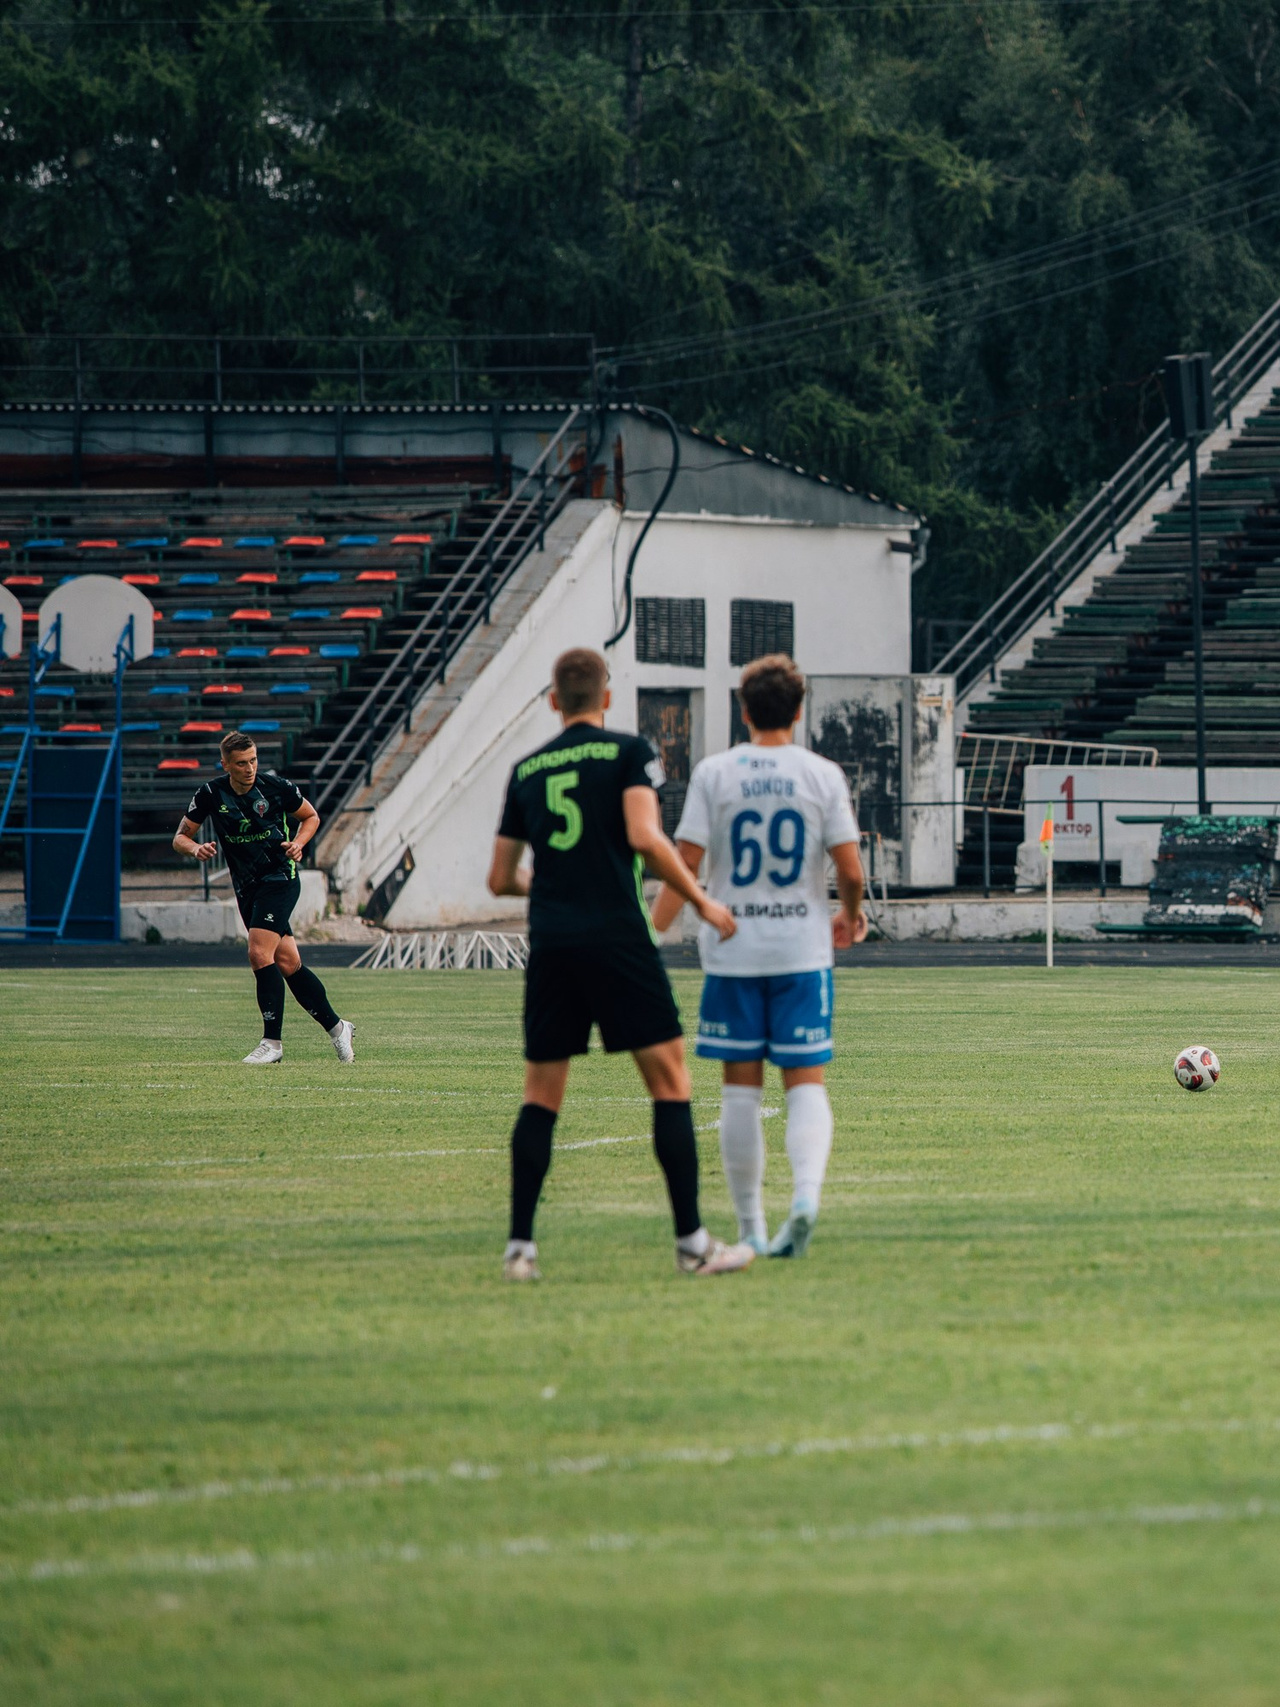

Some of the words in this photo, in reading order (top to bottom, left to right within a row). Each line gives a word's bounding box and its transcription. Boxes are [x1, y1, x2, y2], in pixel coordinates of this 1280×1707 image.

[545, 770, 583, 850] 5
[740, 776, 795, 798] БОКОВ
[1060, 775, 1075, 821] 1
[730, 807, 806, 888] 69
[1053, 823, 1093, 838] ектор
